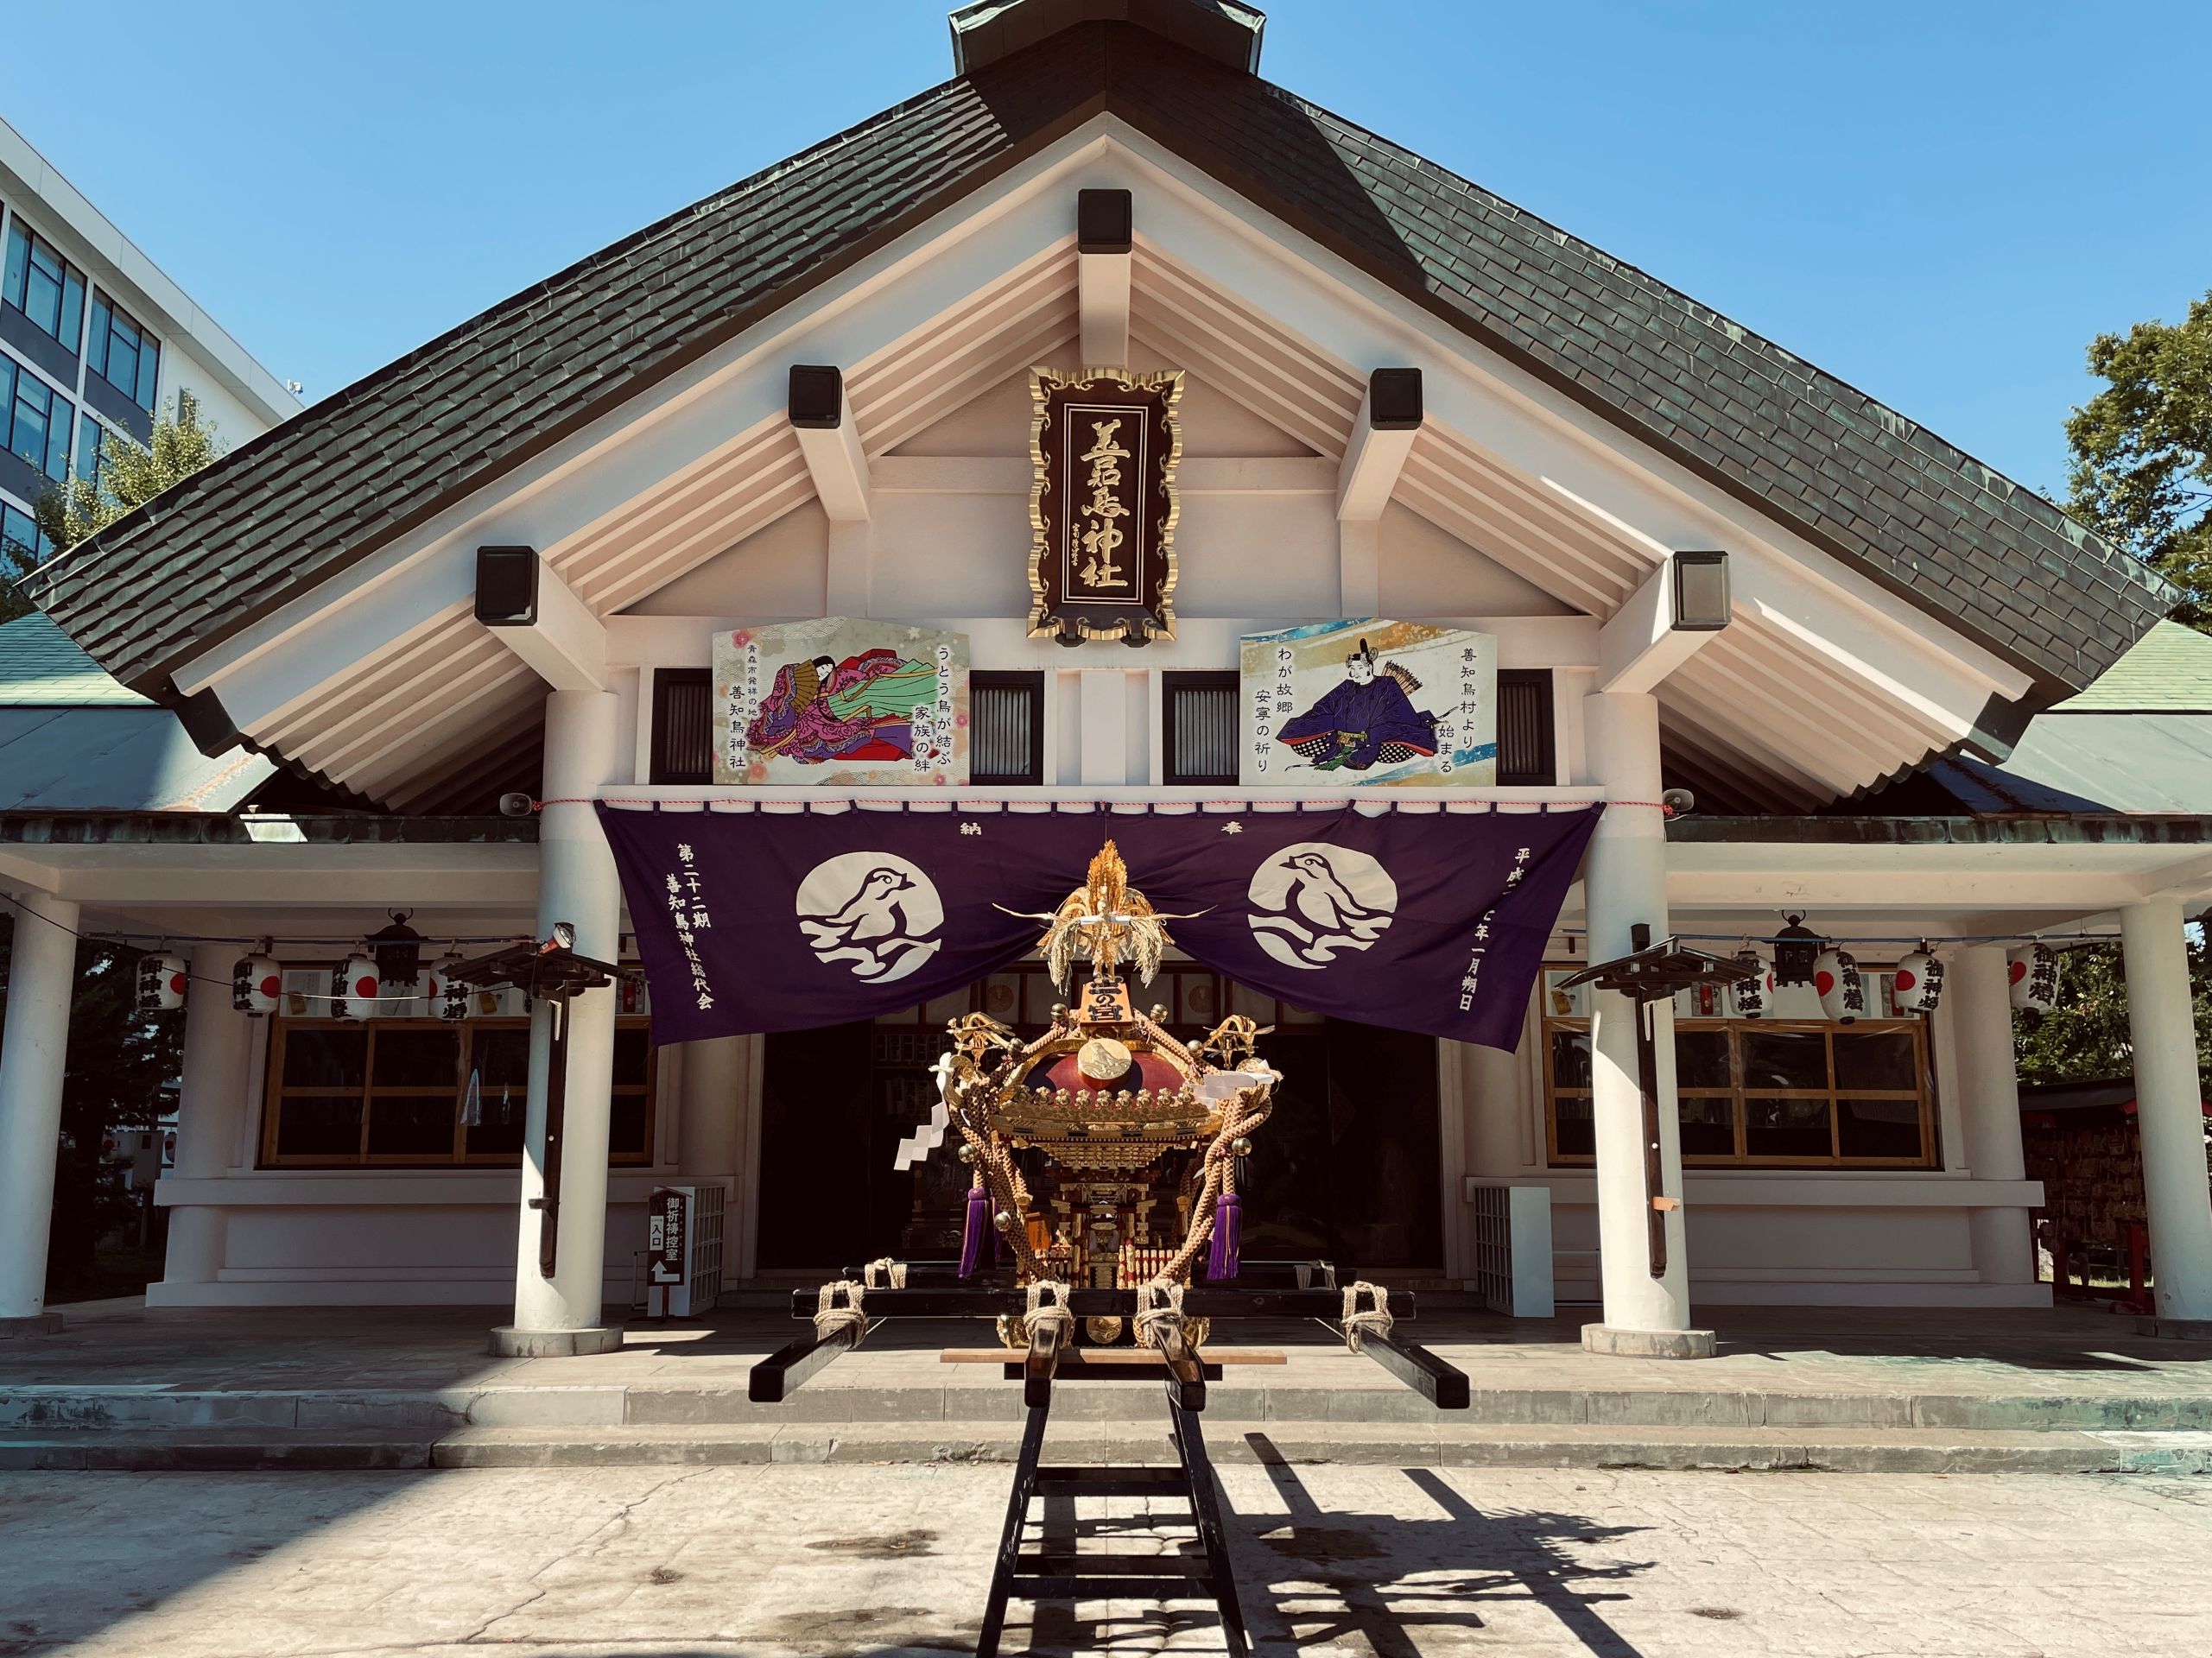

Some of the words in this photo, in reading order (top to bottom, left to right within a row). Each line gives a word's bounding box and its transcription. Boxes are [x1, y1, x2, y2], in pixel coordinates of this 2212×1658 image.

[1080, 418, 1131, 589] 善知鳥神社
[746, 644, 758, 717] 青森市発祥の地
[935, 647, 952, 766] うとう鳥が結ぶ
[1276, 648, 1294, 714] わが故郷
[1460, 647, 1477, 749] 善知鳥村より
[728, 685, 746, 769] 善知鳥神社
[913, 706, 931, 773] 家族の絆
[1254, 689, 1271, 772] 安寧の祈り
[1437, 724, 1455, 773] 始まる
[960, 822, 982, 836] 納
[1220, 820, 1243, 835] 奉
[676, 843, 712, 928] 第二十二期
[666, 873, 715, 1010] 善知鳥神社総代会
[442, 977, 468, 1019] 神燈
[651, 1225, 662, 1246] 入口
